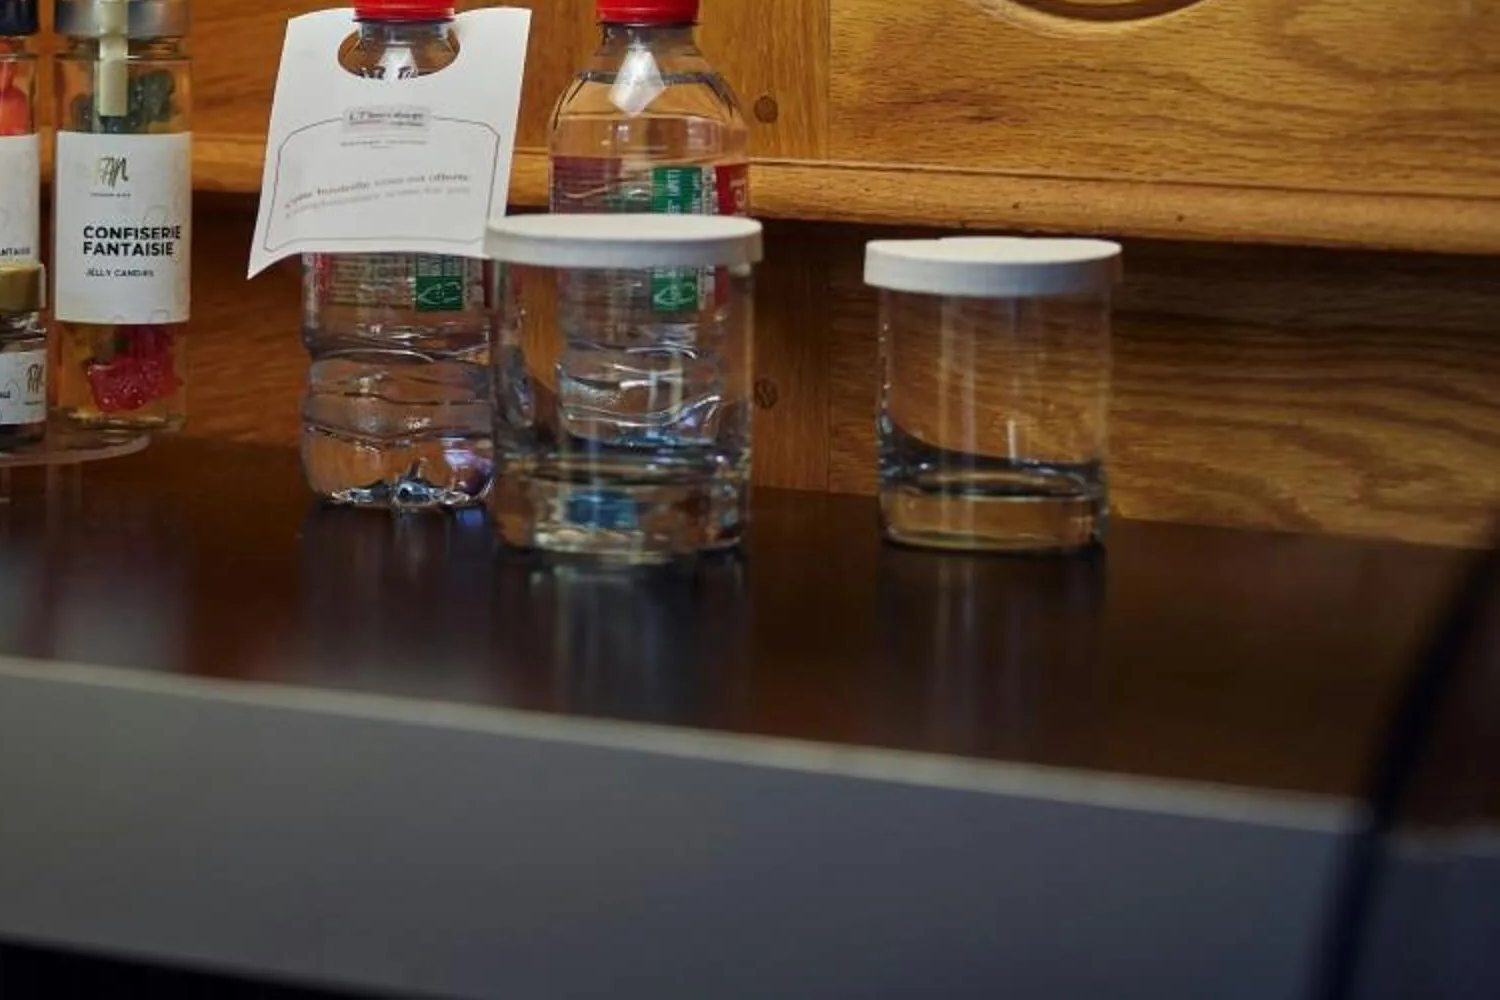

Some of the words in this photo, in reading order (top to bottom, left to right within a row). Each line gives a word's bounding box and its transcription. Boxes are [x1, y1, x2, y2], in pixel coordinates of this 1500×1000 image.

[83, 226, 181, 240] CONFISERIE
[83, 241, 174, 256] FANTAISIE
[86, 268, 112, 278] JELLY
